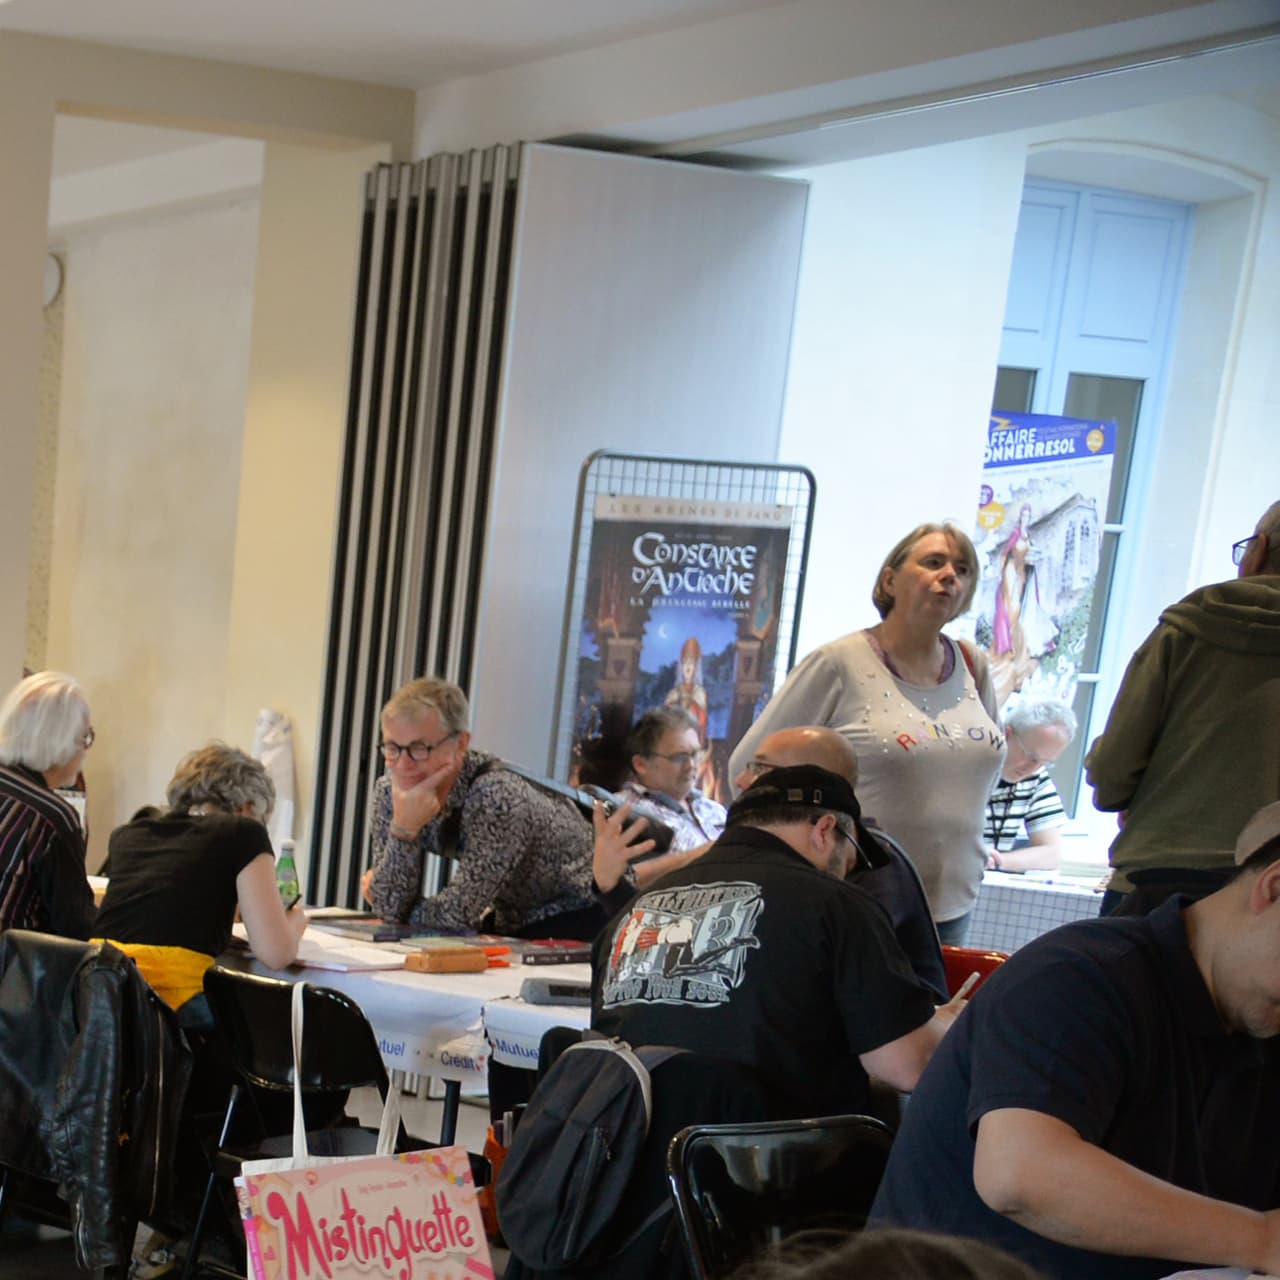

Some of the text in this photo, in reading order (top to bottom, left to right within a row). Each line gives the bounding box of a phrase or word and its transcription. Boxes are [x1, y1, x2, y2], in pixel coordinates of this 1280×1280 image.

[987, 428, 1037, 448] FFAIRE
[984, 438, 1076, 464] ONNERRESOL
[495, 1038, 540, 1060] Mutue
